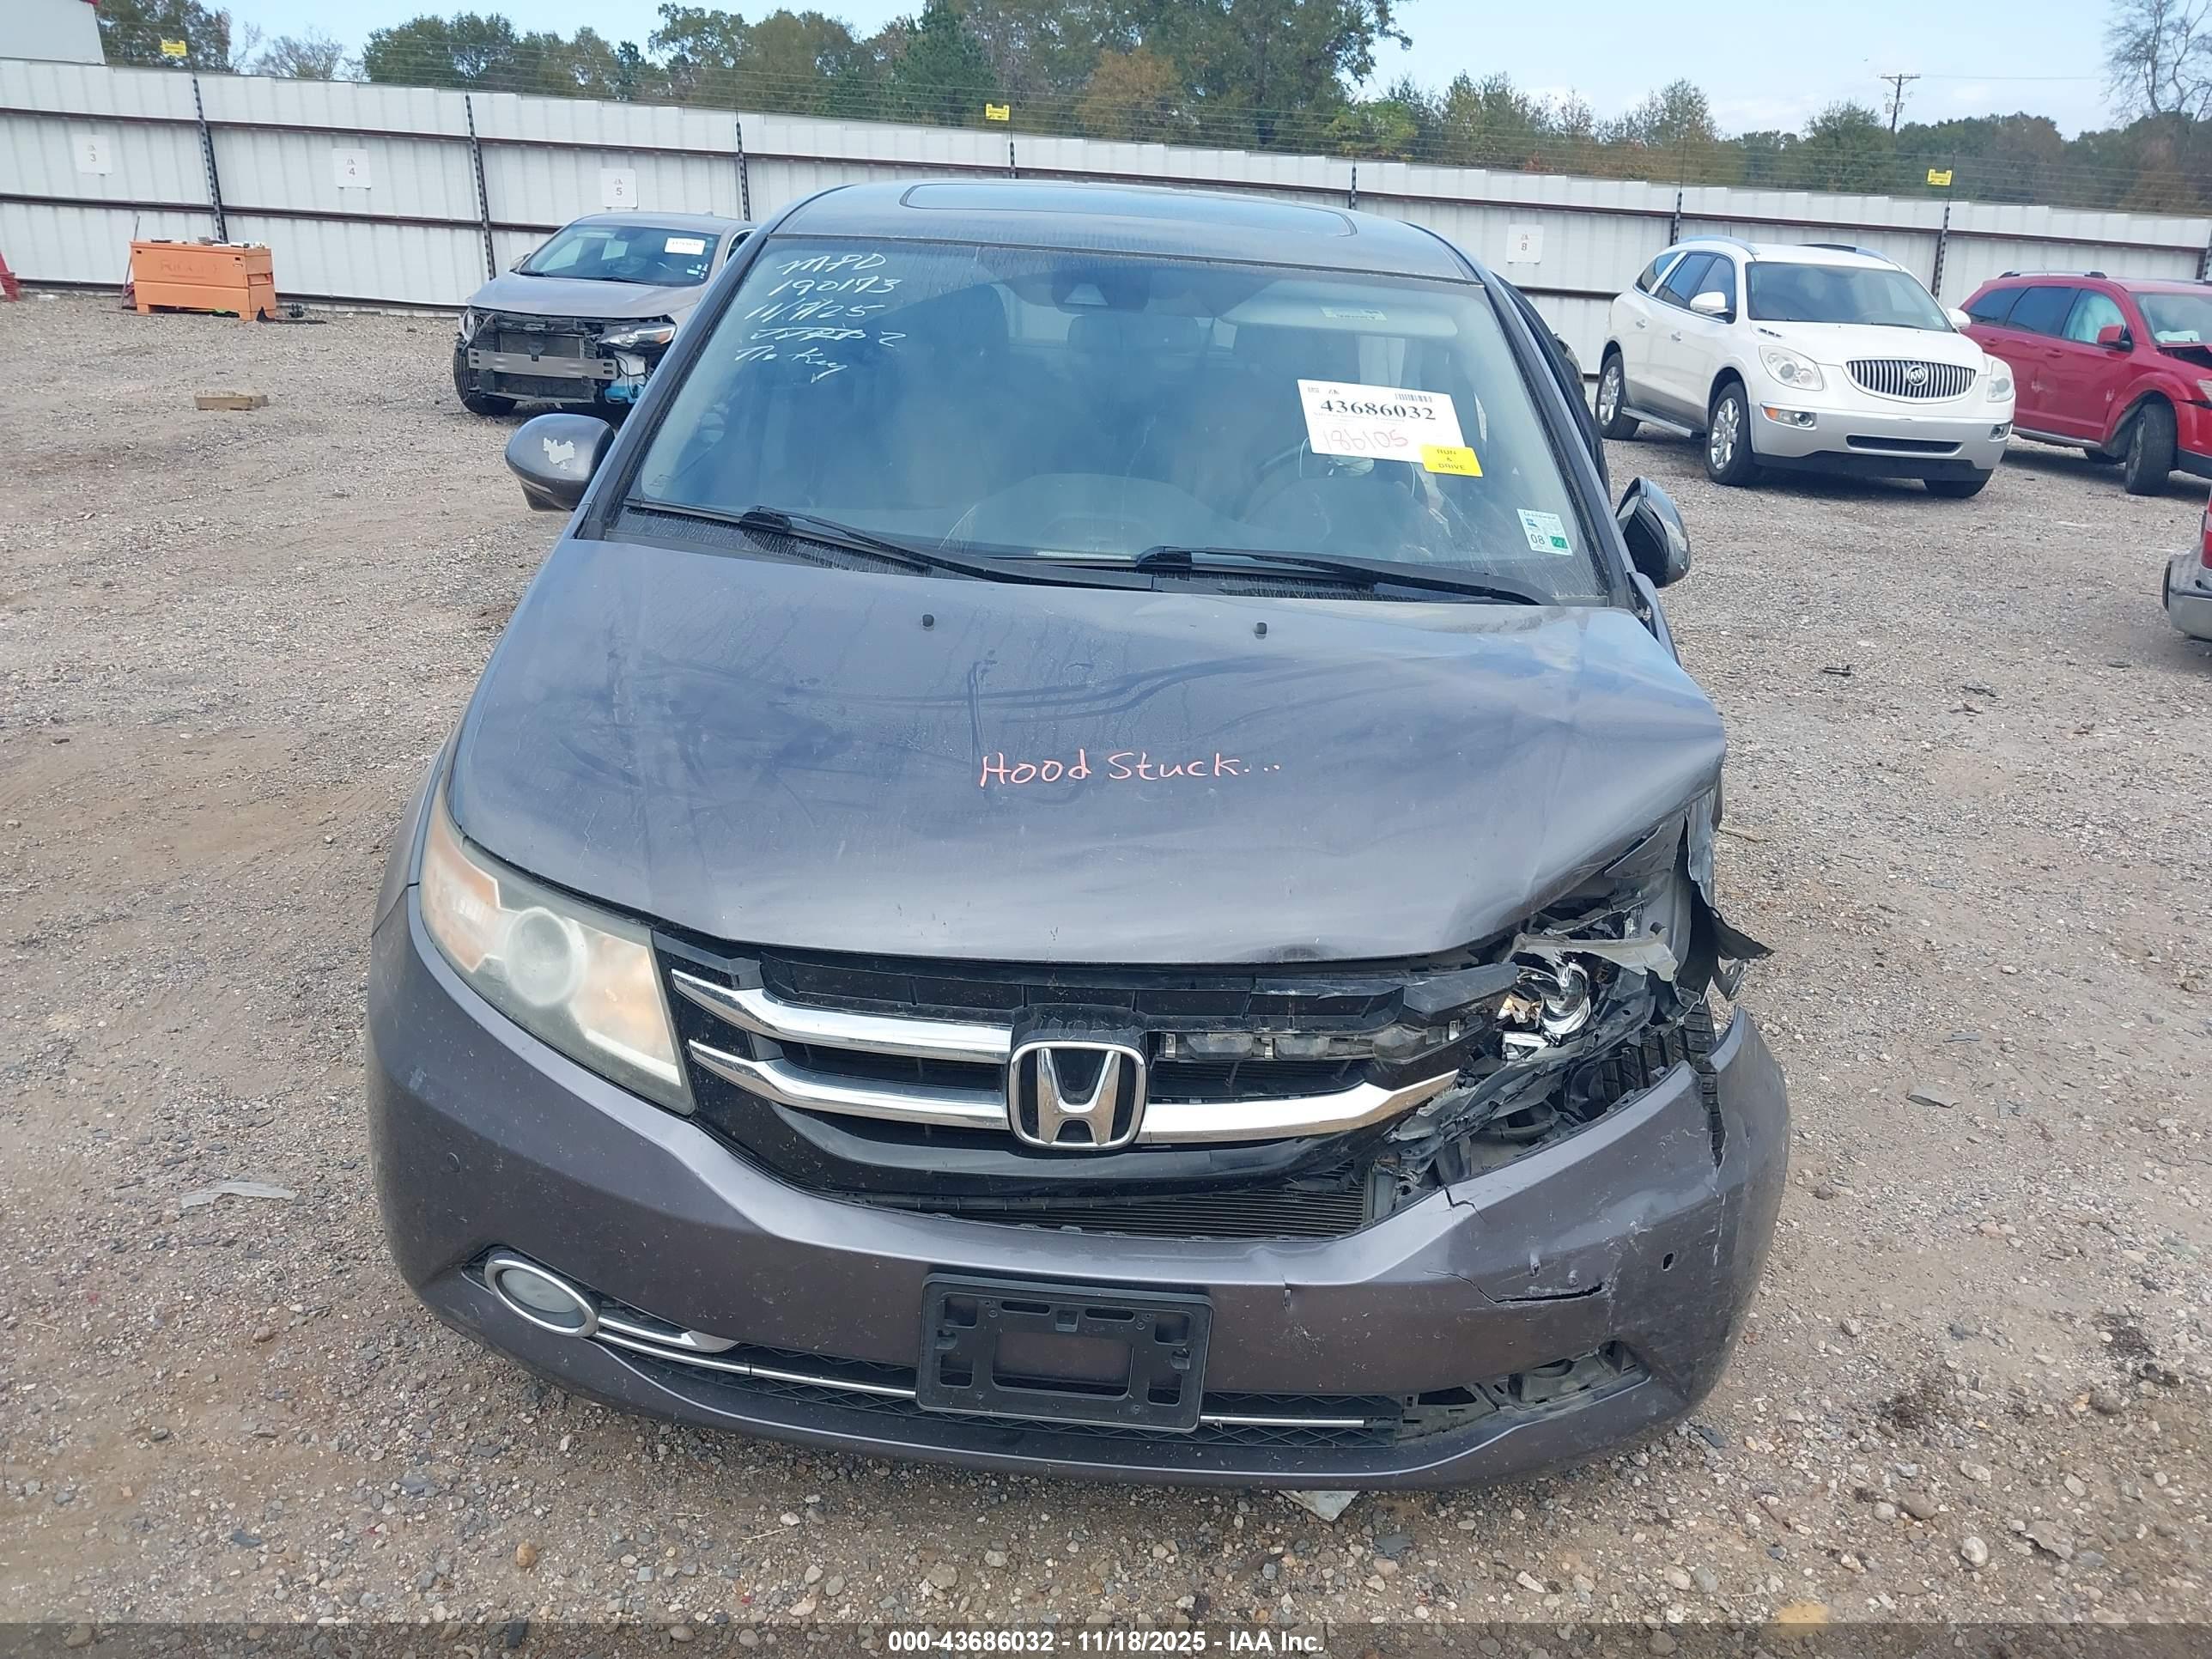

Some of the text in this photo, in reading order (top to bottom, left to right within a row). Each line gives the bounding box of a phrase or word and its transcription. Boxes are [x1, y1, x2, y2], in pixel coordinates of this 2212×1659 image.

[1320, 399, 1437, 421] 43686032
[1531, 534, 1546, 545] 08
[980, 749, 1092, 788] Hood
